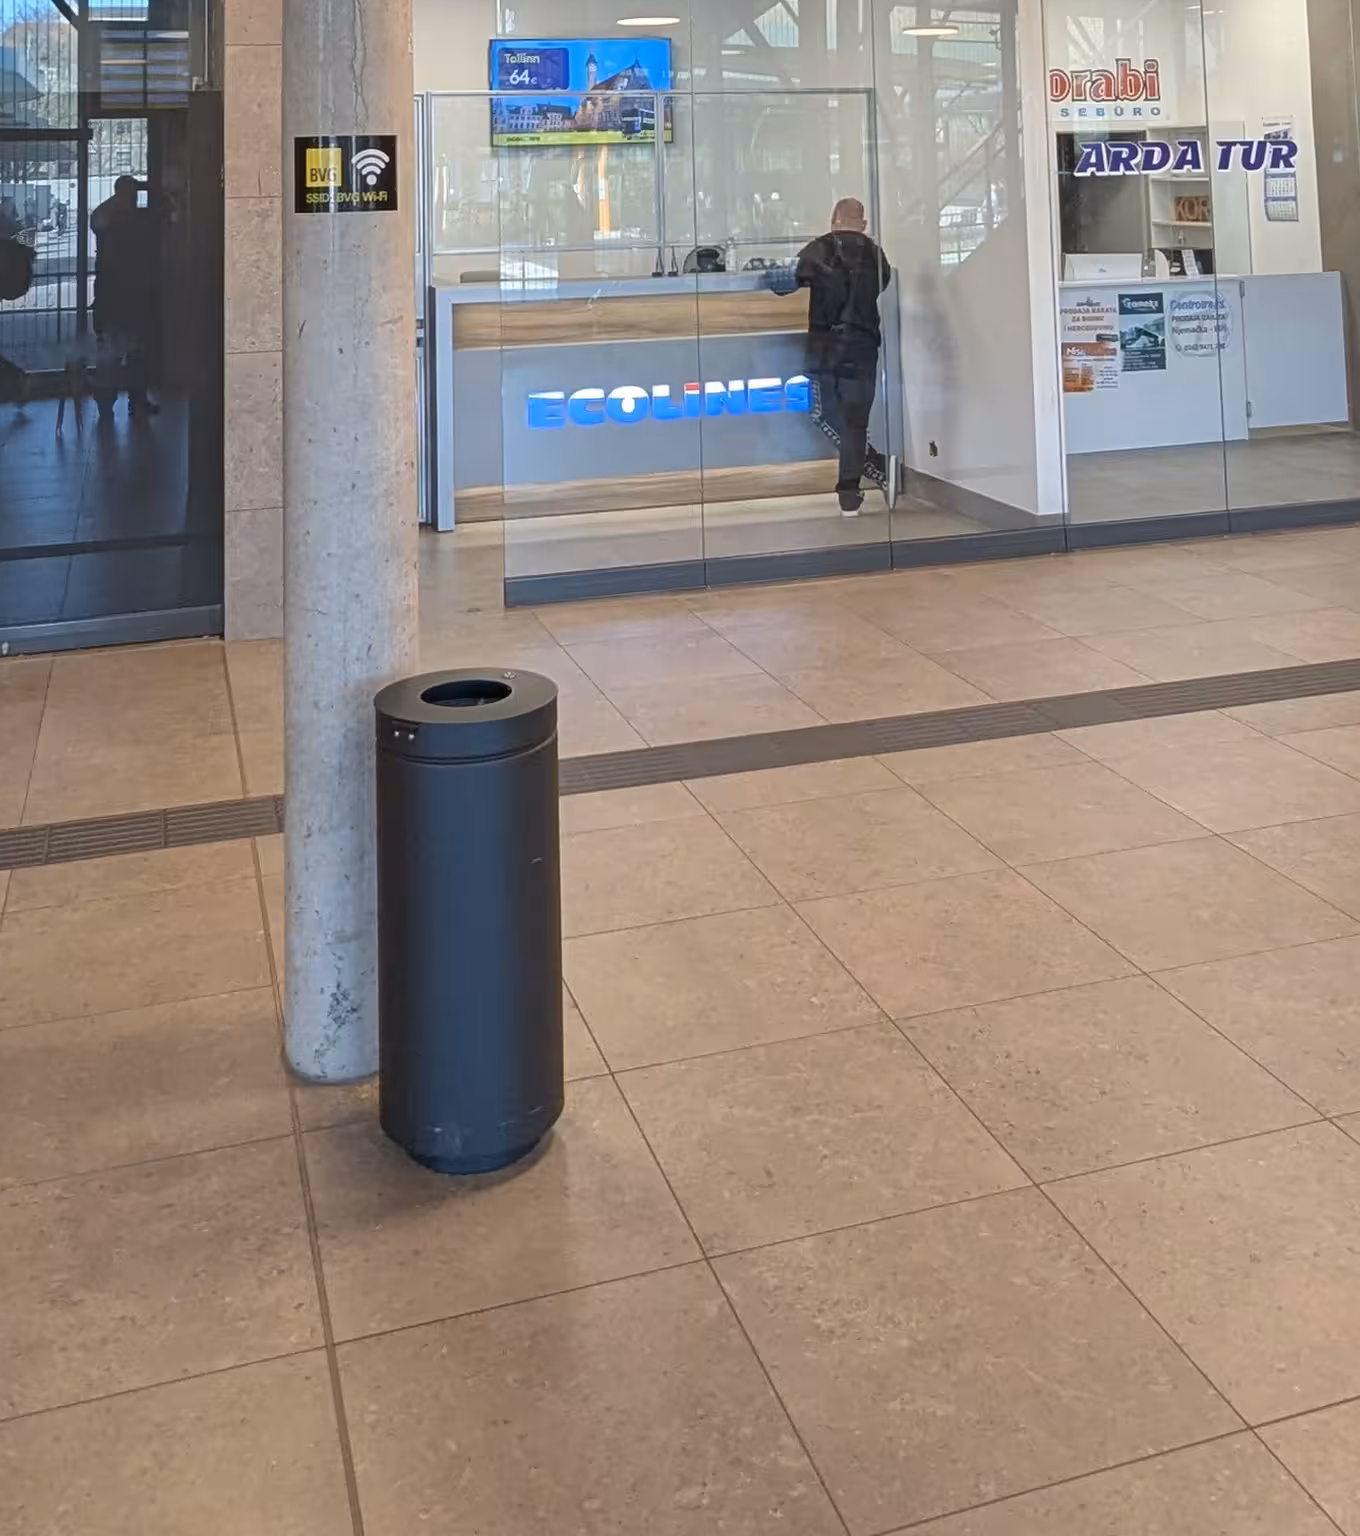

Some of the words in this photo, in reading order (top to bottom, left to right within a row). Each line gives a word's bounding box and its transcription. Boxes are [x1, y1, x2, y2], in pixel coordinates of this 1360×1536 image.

[1073, 140, 1204, 177] ARDA
[1216, 139, 1299, 173] TUR
[310, 167, 337, 183] BVG
